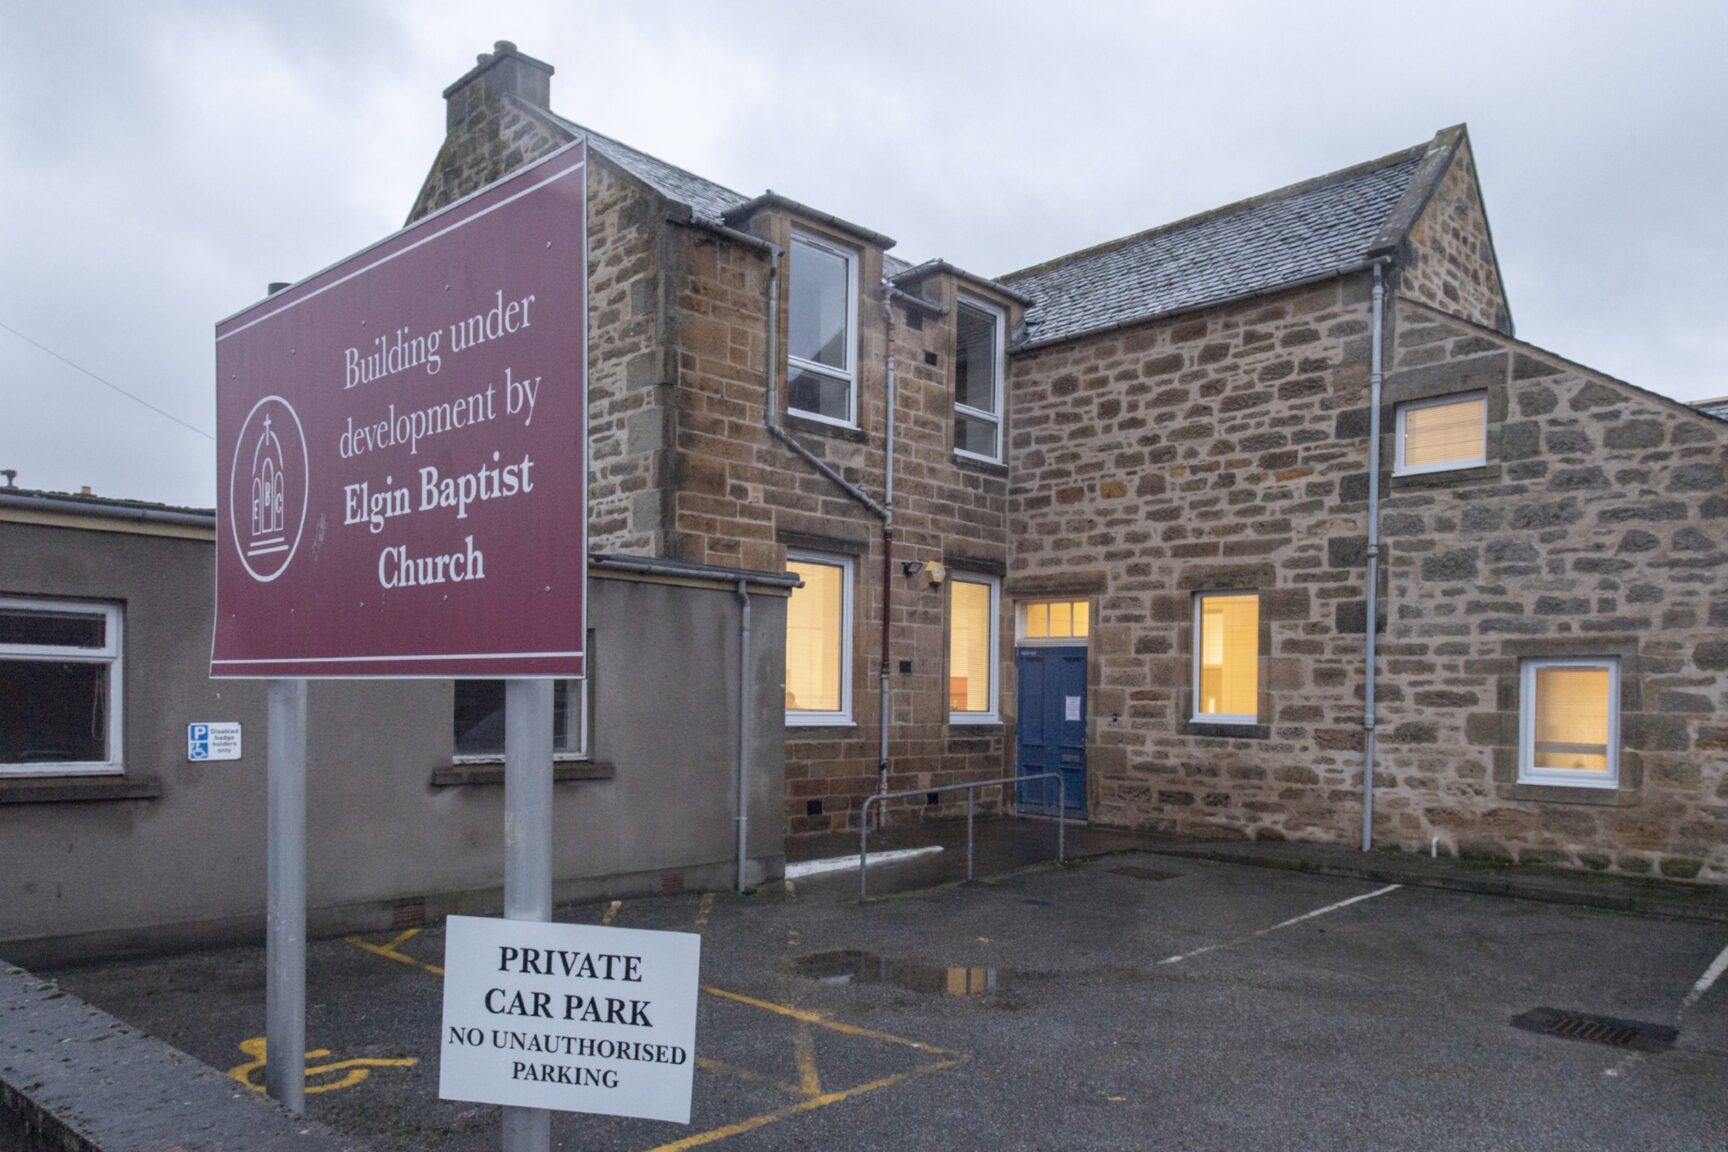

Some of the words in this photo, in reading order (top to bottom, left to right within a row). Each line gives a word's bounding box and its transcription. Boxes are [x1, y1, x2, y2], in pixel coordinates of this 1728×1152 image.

[343, 327, 442, 389] Building
[451, 290, 535, 353] under
[339, 384, 496, 458] development
[505, 367, 542, 426] by
[343, 475, 411, 533] Elgin
[418, 450, 534, 519] Baptist
[378, 535, 485, 588] Church
[194, 726, 206, 739] P
[498, 946, 642, 982] PRIVATE
[484, 987, 554, 1019] CAR
[563, 993, 653, 1028] PARK
[448, 1026, 485, 1047] NO
[491, 1029, 687, 1066] UNAUTHORISED
[511, 1061, 620, 1089] PARKING
